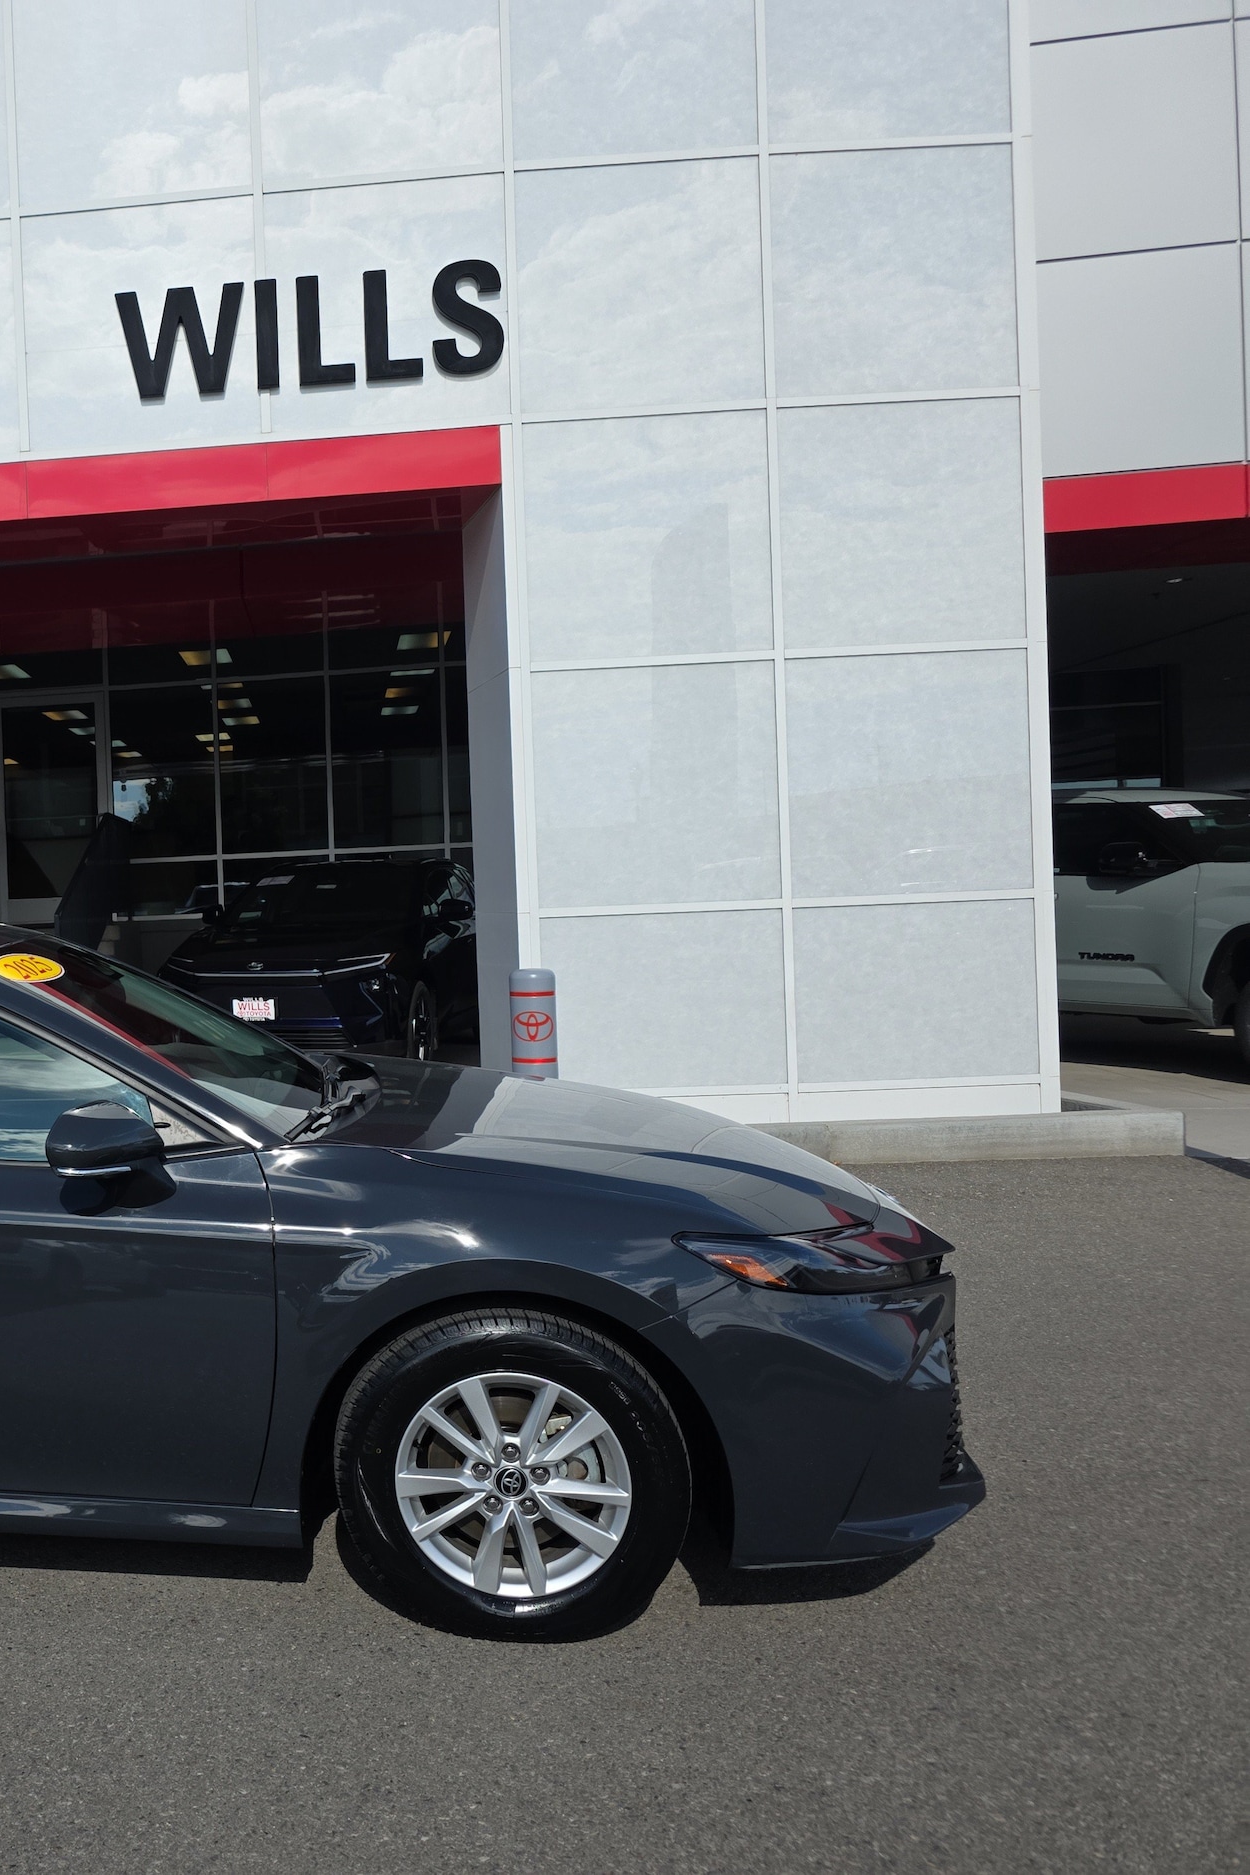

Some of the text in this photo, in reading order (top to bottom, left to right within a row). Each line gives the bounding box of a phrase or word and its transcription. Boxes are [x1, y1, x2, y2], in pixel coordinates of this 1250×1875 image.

[114, 259, 505, 399] WILLS
[1078, 951, 1135, 961] TUNDRA
[3, 956, 53, 980] 2025
[237, 1001, 270, 1011] WILLS
